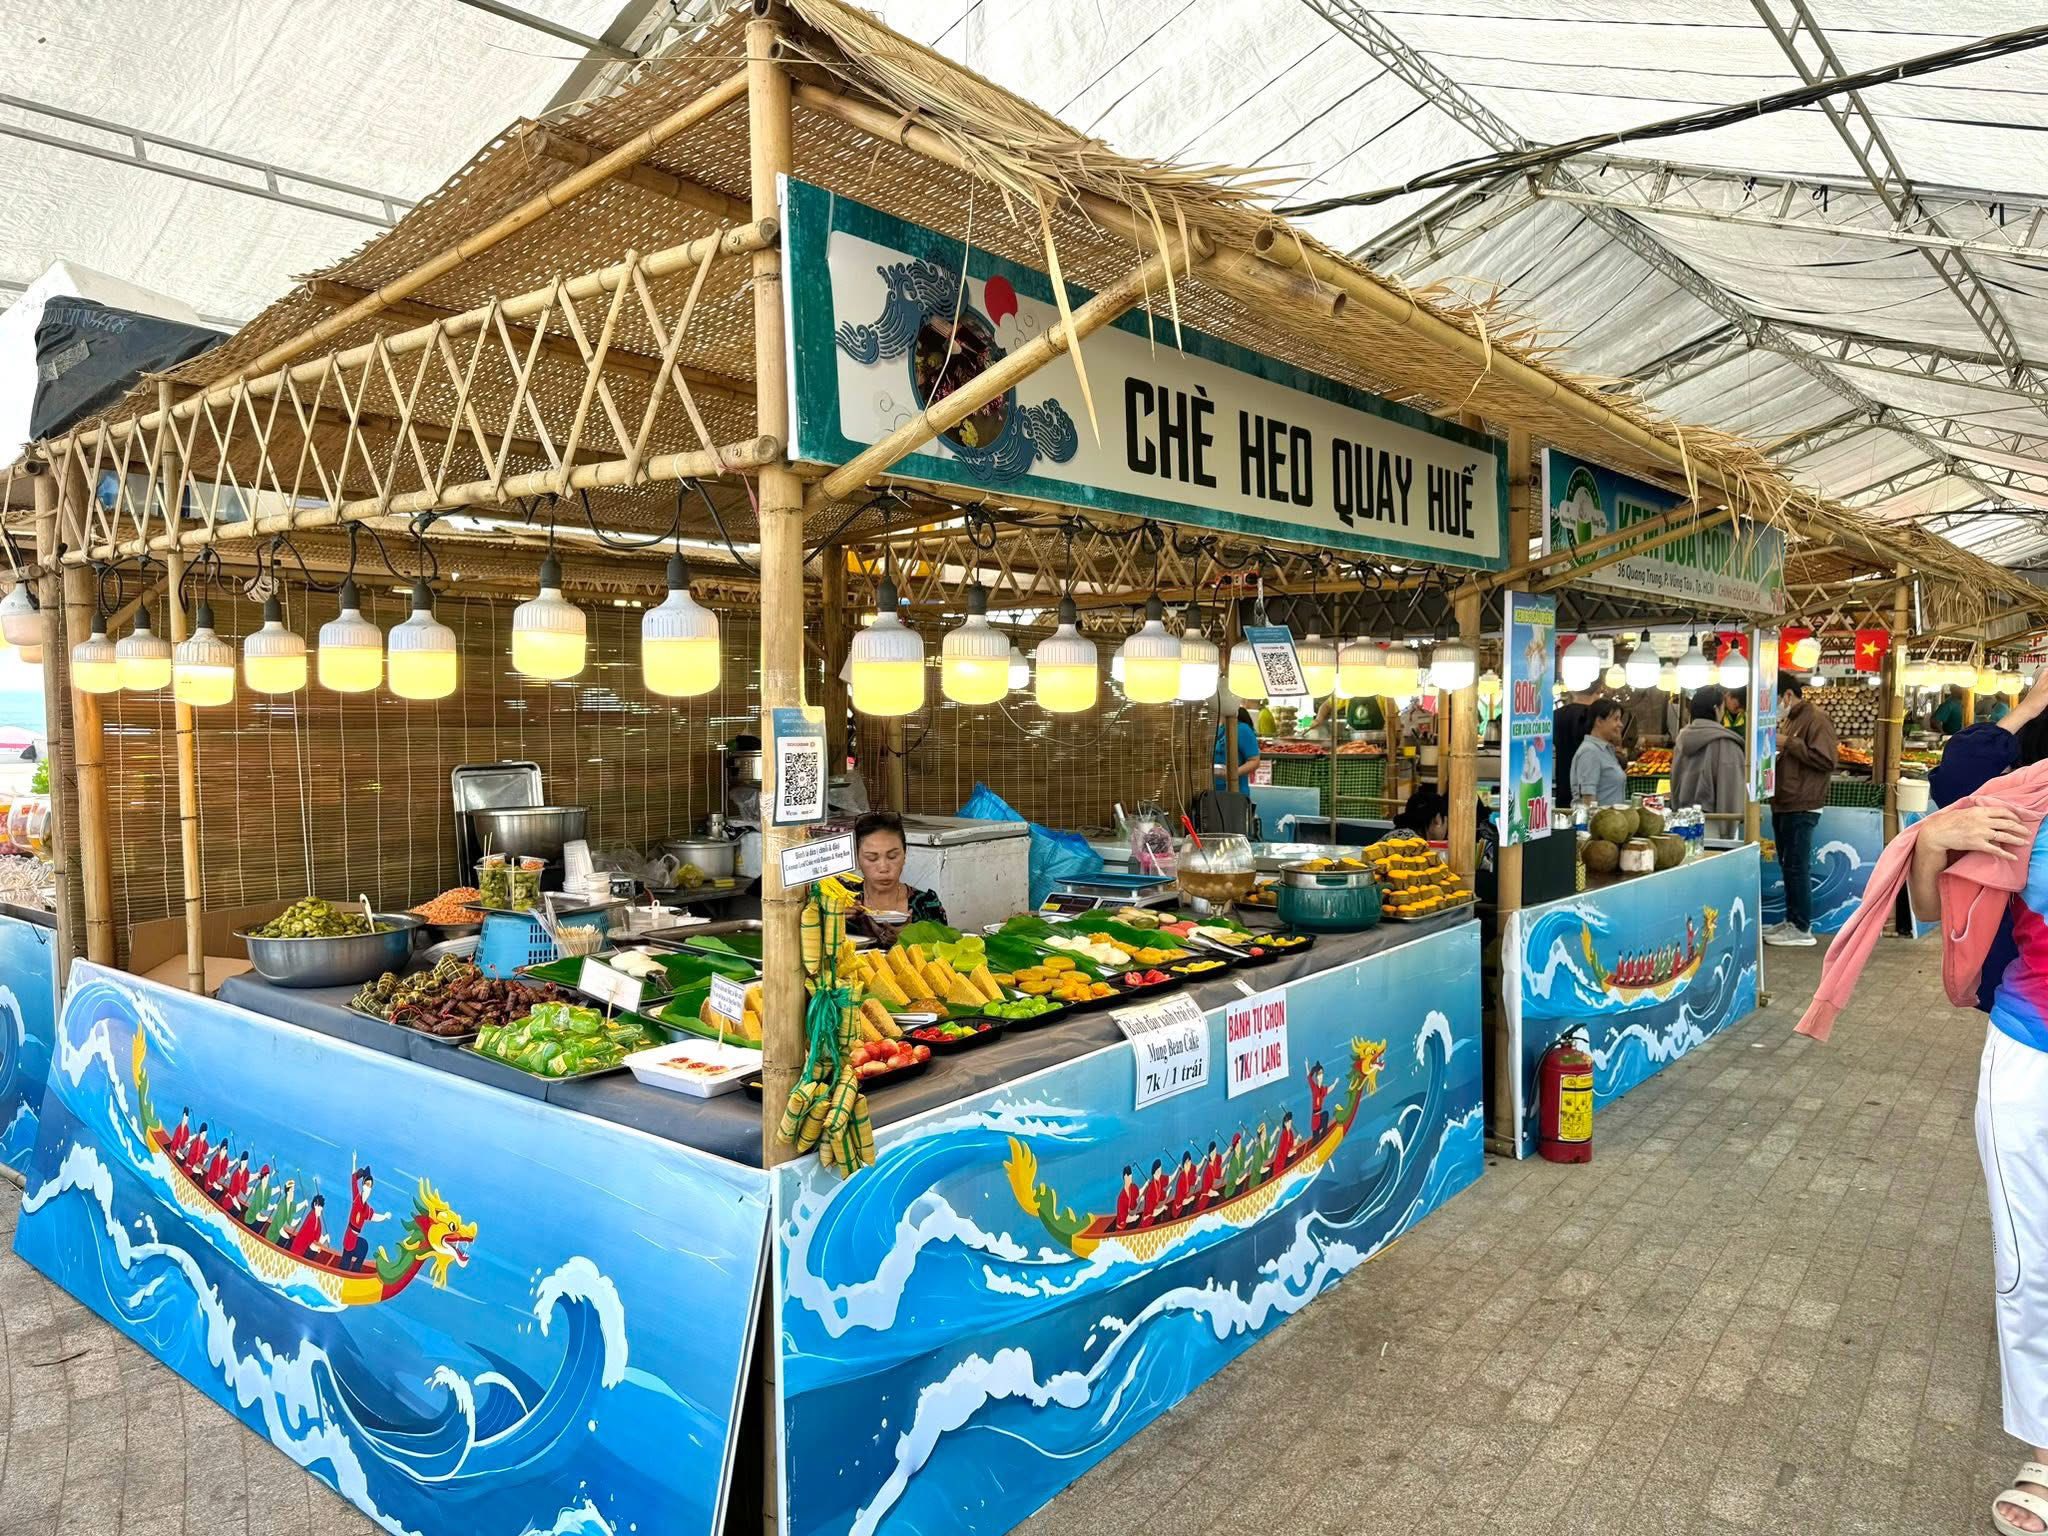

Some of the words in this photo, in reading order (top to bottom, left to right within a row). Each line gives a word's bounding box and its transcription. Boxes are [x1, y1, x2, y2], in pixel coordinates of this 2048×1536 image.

[1124, 375, 1217, 489] CHÈ
[1238, 409, 1313, 508] HEO
[1331, 437, 1412, 529] QUAY
[1427, 463, 1478, 540] HUẾ
[1626, 565, 1645, 586] Quang
[1228, 1007, 1251, 1043] BÁNH
[1252, 1003, 1263, 1040] TỰ
[1264, 1000, 1285, 1034] CHỌN
[1147, 1042, 1169, 1064] Mung
[1168, 1038, 1184, 1057] Bean
[1183, 1031, 1200, 1052] Cake
[1254, 1050, 1259, 1076] 1
[1261, 1042, 1282, 1078] LẠNG
[1146, 1070, 1160, 1095] 7k
[1163, 1070, 1170, 1089] /
[1171, 1067, 1178, 1086] 1
[1181, 1057, 1203, 1082] trái
